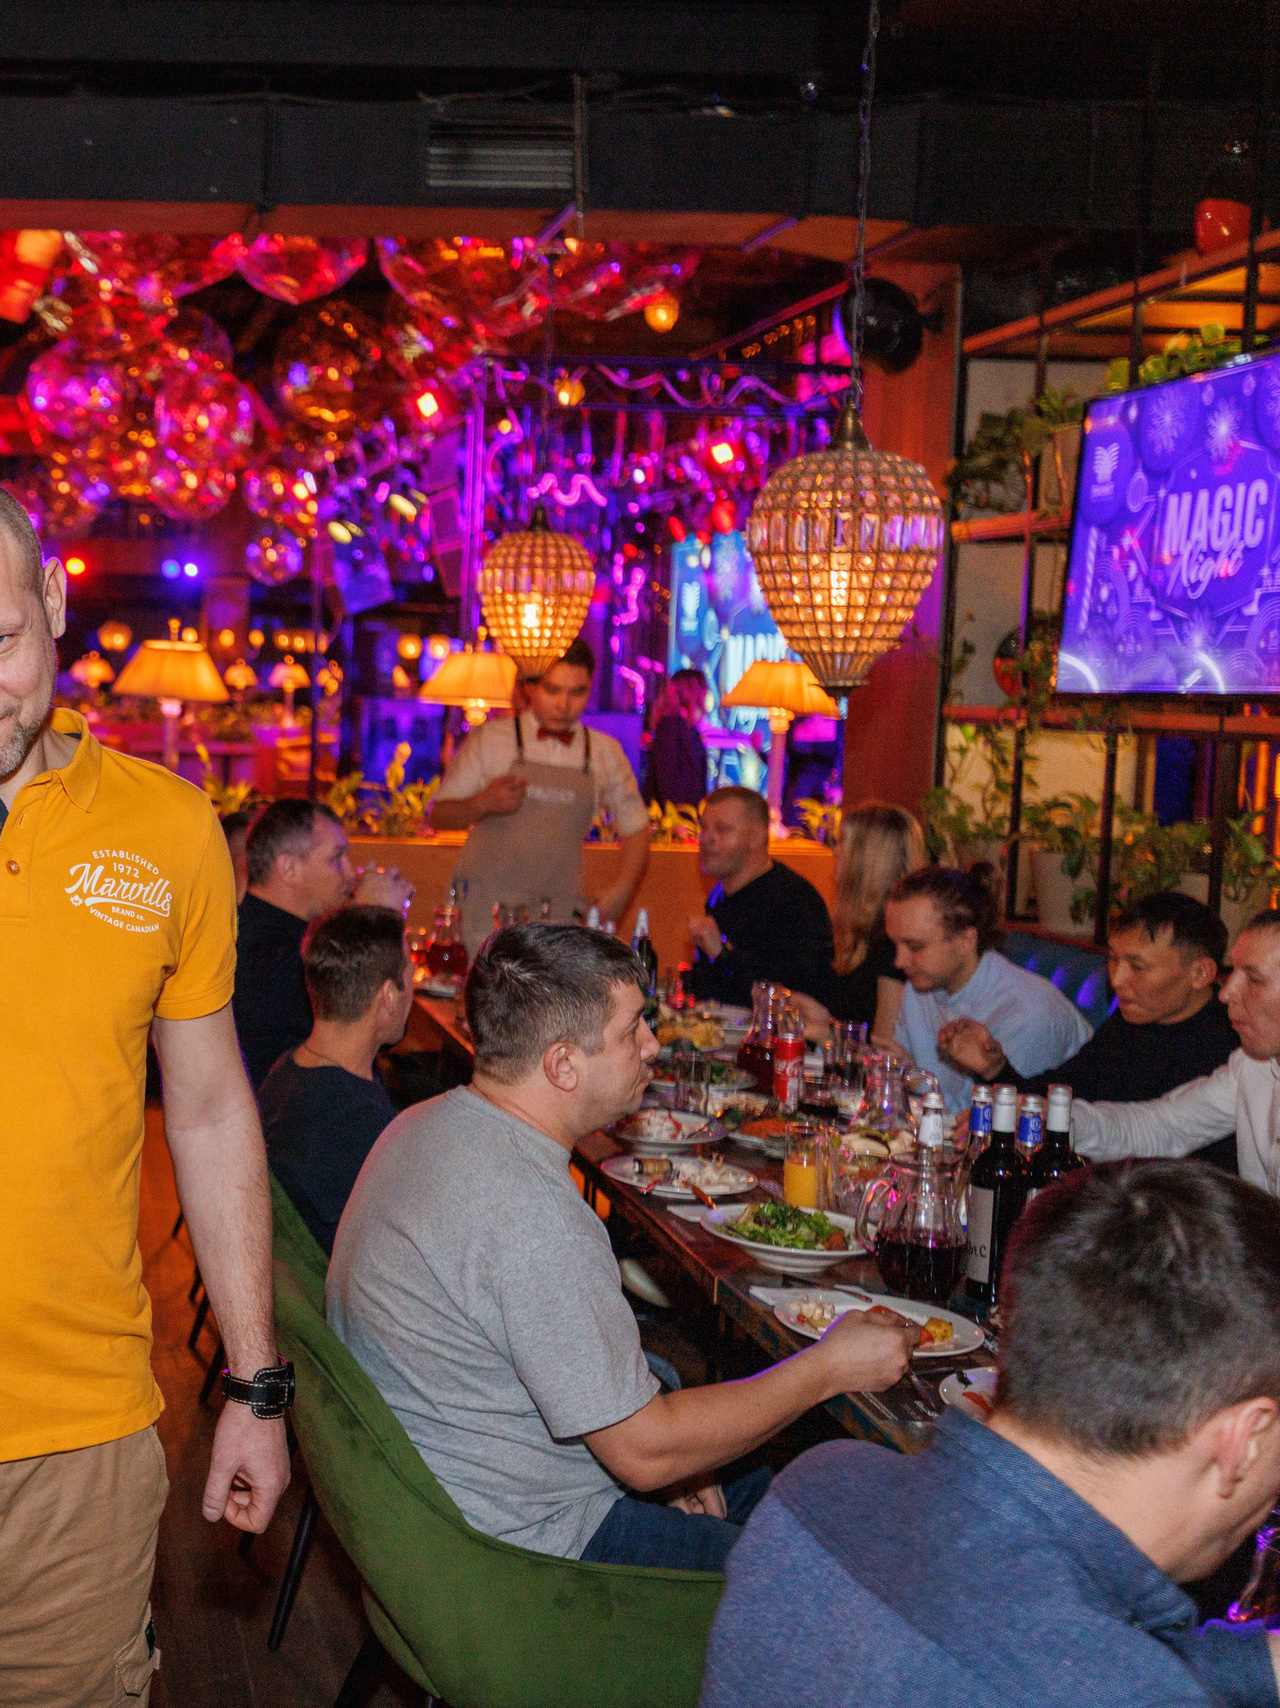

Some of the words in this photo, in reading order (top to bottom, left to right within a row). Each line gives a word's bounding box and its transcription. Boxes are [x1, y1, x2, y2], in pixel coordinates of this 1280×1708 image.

[1162, 479, 1268, 559] MAGIC
[92, 849, 159, 875] ESTABLISHED
[112, 862, 139, 878] 1972
[64, 863, 173, 912] Marville
[89, 906, 124, 929] VINTAGE
[125, 923, 160, 933] CANADIAN
[111, 906, 135, 918] BRAND
